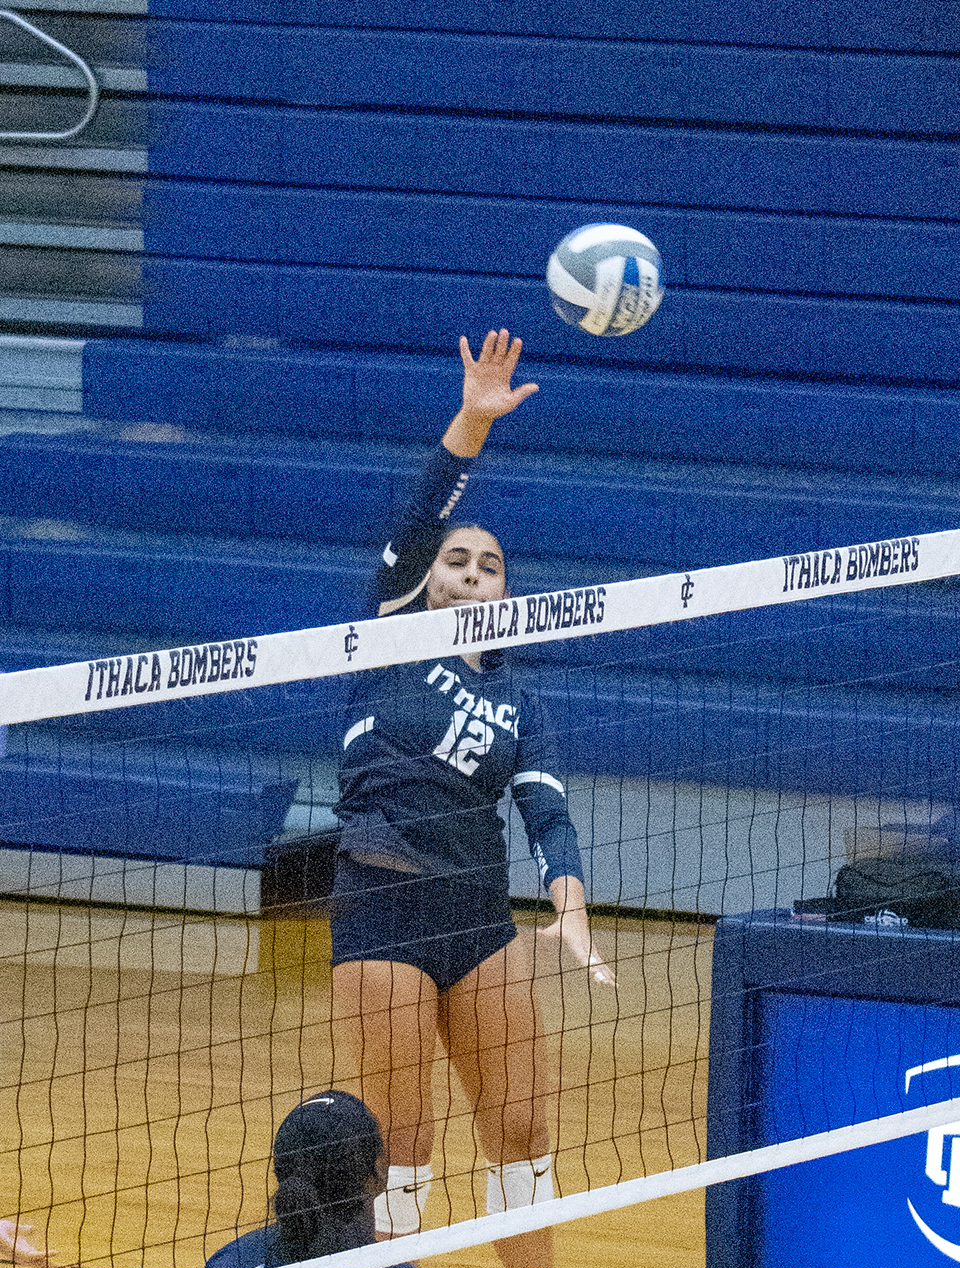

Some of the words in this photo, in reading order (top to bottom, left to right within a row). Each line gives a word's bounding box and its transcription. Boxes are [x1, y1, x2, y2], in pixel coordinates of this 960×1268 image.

[782, 549, 842, 592] ITHACA
[845, 537, 920, 581] BOMBERS
[452, 602, 519, 646] ITHACA
[525, 586, 607, 634] BOMBERS
[84, 653, 161, 701] ITHACA
[167, 639, 259, 689] BOMBERS
[432, 710, 496, 777] 12
